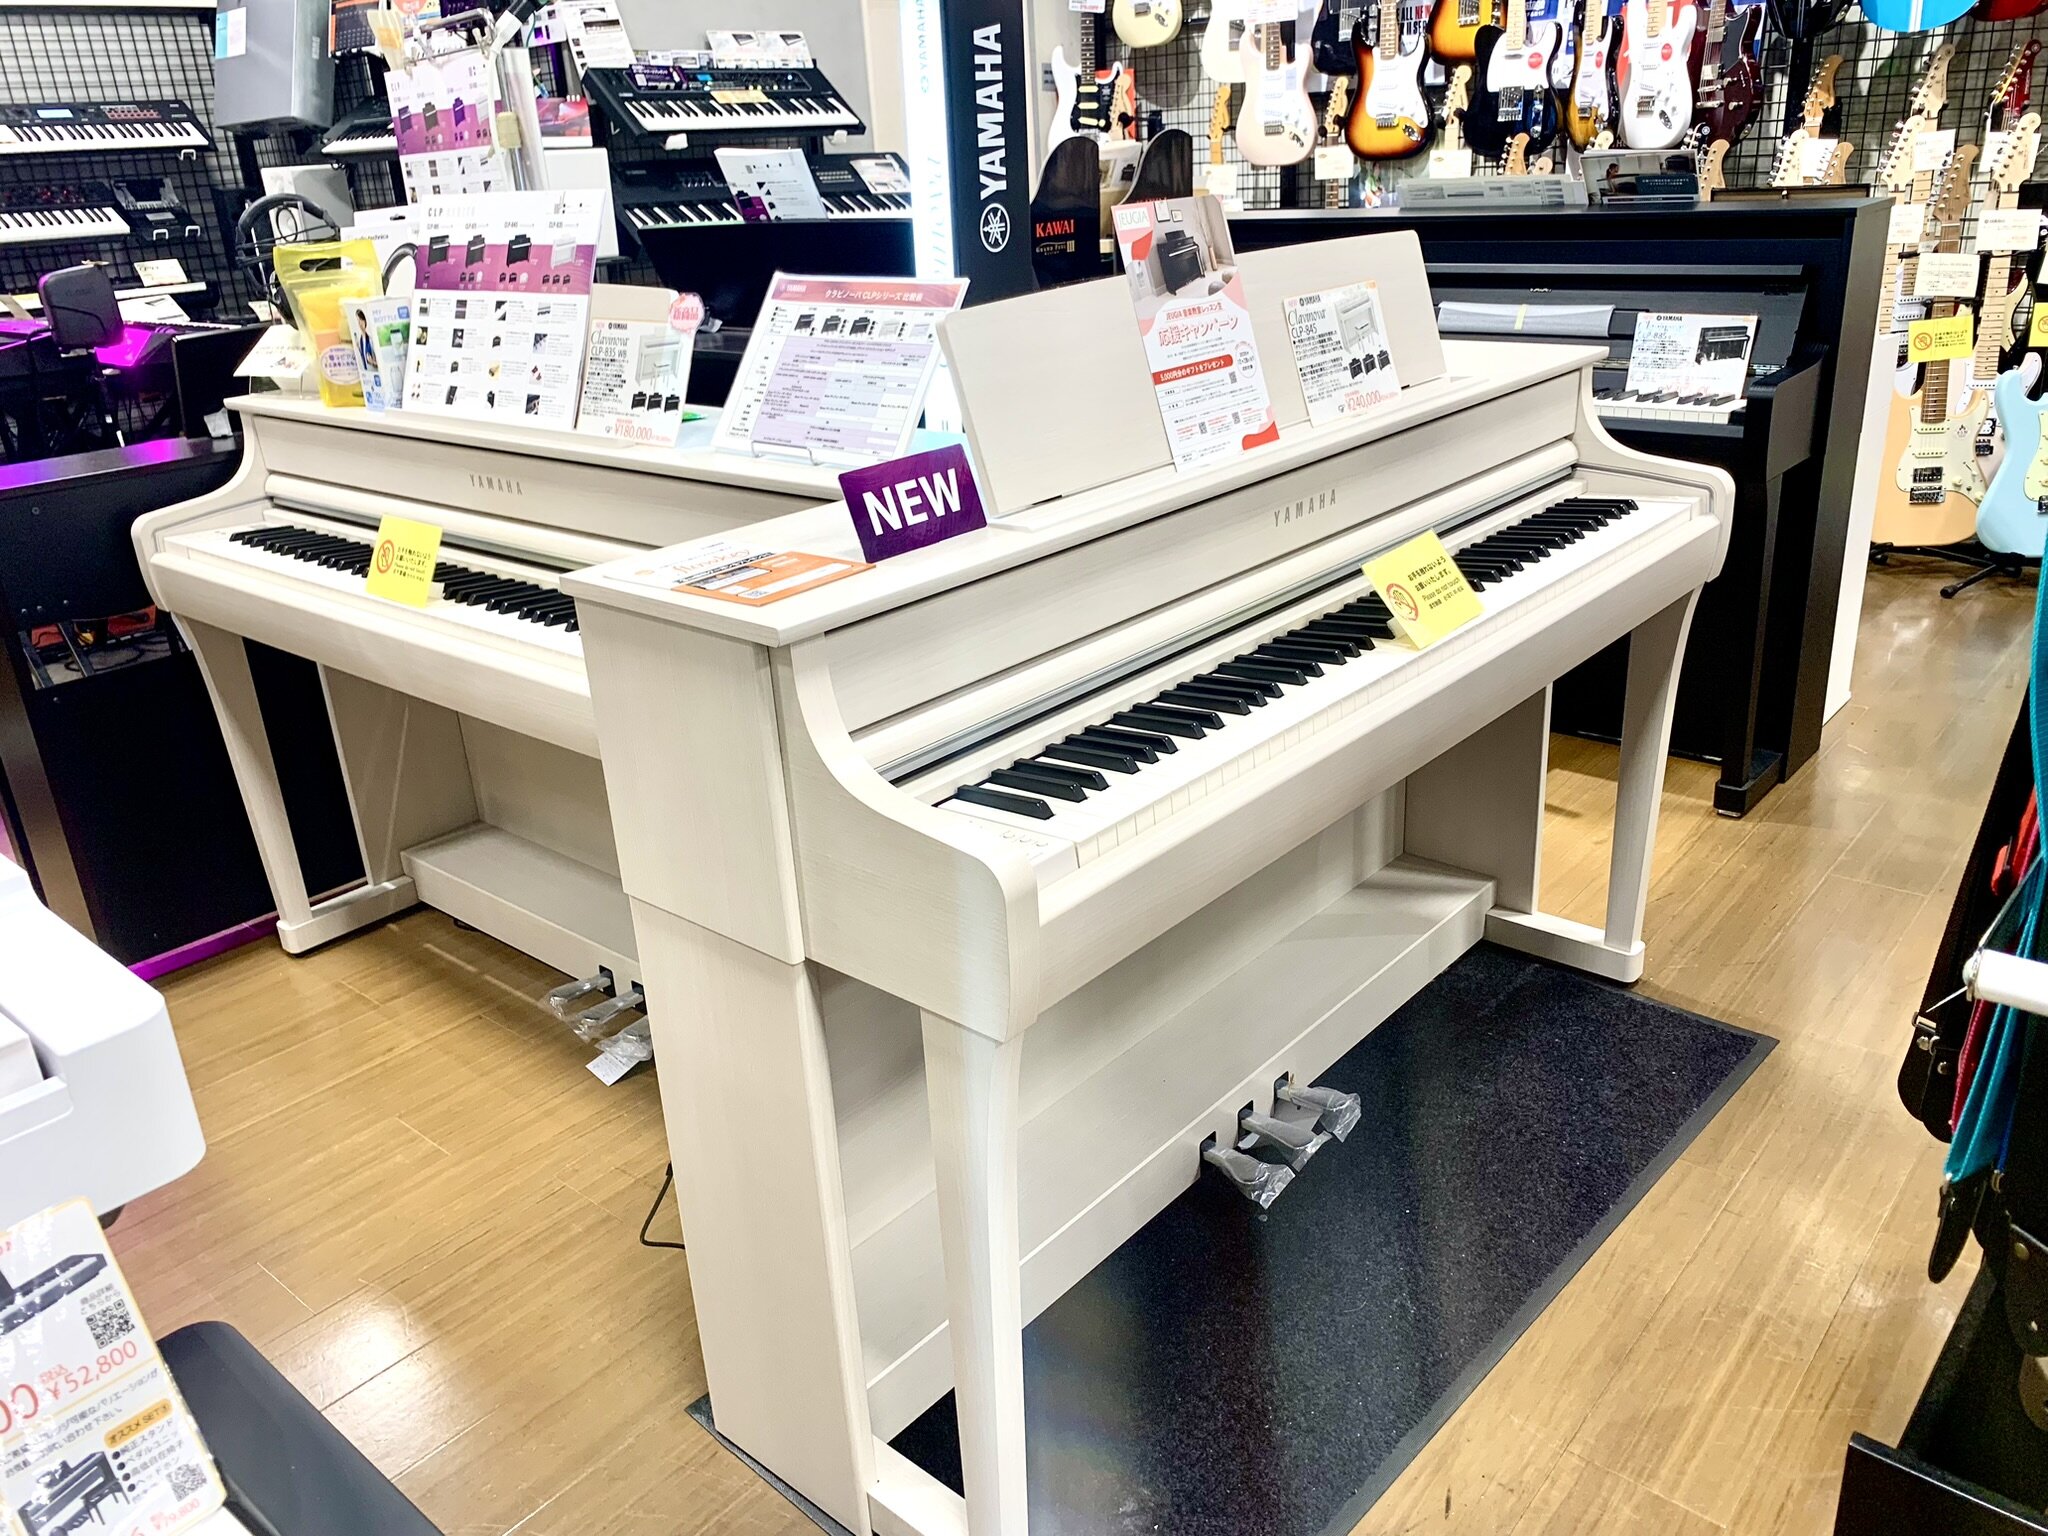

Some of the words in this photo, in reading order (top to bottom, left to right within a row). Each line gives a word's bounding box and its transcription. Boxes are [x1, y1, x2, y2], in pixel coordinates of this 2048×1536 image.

[973, 23, 1007, 200] YAMAHA
[1036, 219, 1074, 237] KAWAI
[1119, 210, 1149, 230] JEUGIA
[1304, 294, 1321, 305] YAMAHA
[612, 322, 628, 330] YAMAHA
[1288, 308, 1326, 327] Clavinova
[591, 330, 630, 347] Clavinova
[1159, 315, 1239, 347] 応援キャンペーン
[1291, 322, 1318, 339] CLP-845
[591, 345, 616, 358] CLP-835
[614, 423, 653, 441] ¥180,000
[469, 474, 523, 496] YAMAHA
[862, 468, 961, 537] NEW
[1274, 488, 1336, 528] YAMAHA
[395, 554, 427, 567] お願いいたします。
[397, 546, 431, 559] お手を触れないよう
[1407, 555, 1447, 582] お手を触れないよう
[1415, 568, 1451, 592] お願いいたします。
[1422, 591, 1436, 602] Please
[47, 1340, 137, 1400] ¥52,800
[118, 1418, 174, 1456] 純正スタンド
